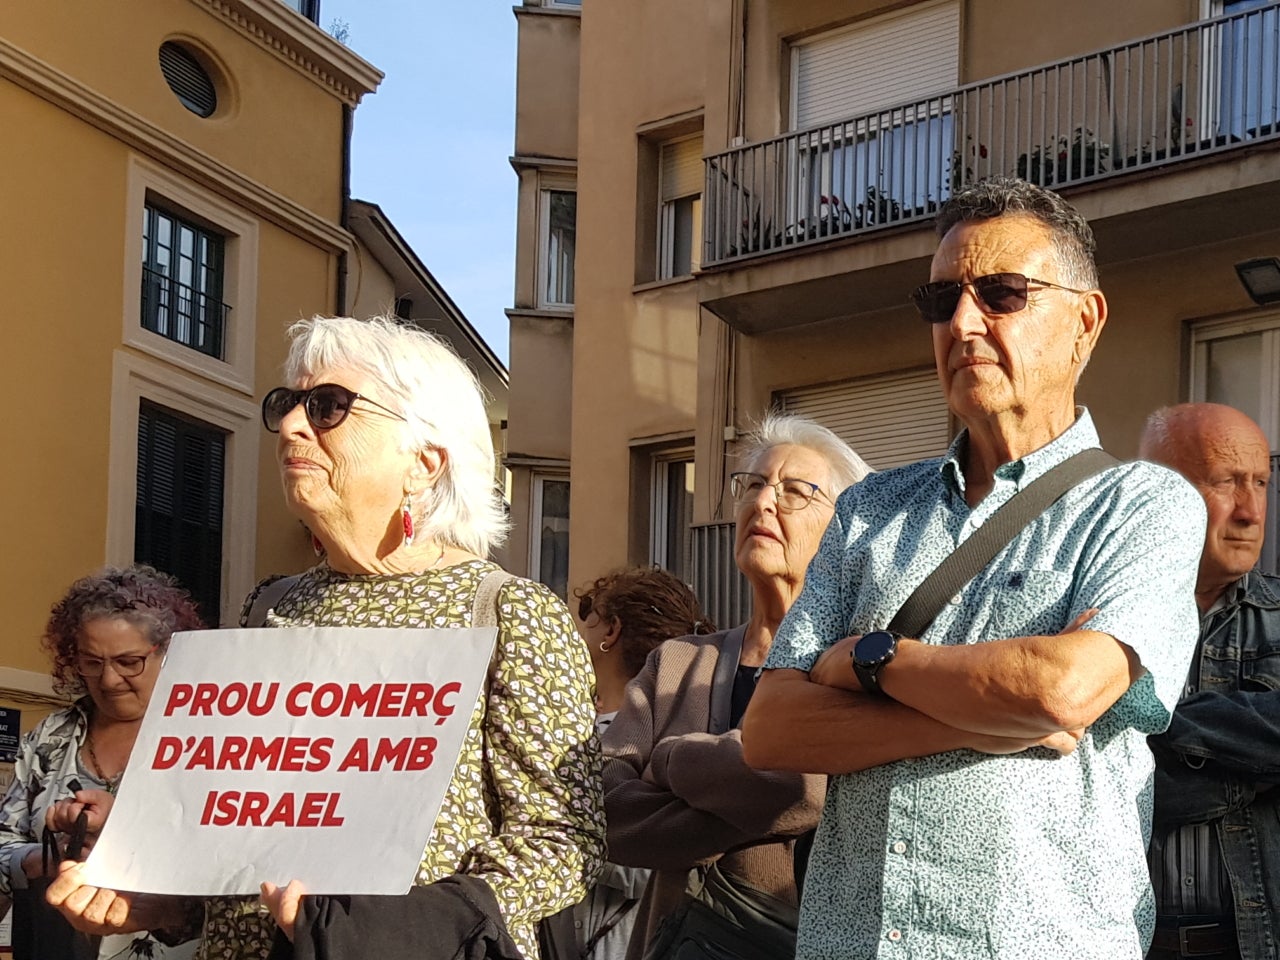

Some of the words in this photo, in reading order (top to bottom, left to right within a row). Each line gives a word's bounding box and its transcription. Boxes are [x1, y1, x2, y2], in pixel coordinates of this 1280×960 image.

[163, 682, 280, 717] PROU
[285, 682, 462, 726] COMERÇ
[151, 736, 333, 771] D’ARMES
[337, 737, 438, 772] AMB
[200, 790, 345, 827] ISRAEL
